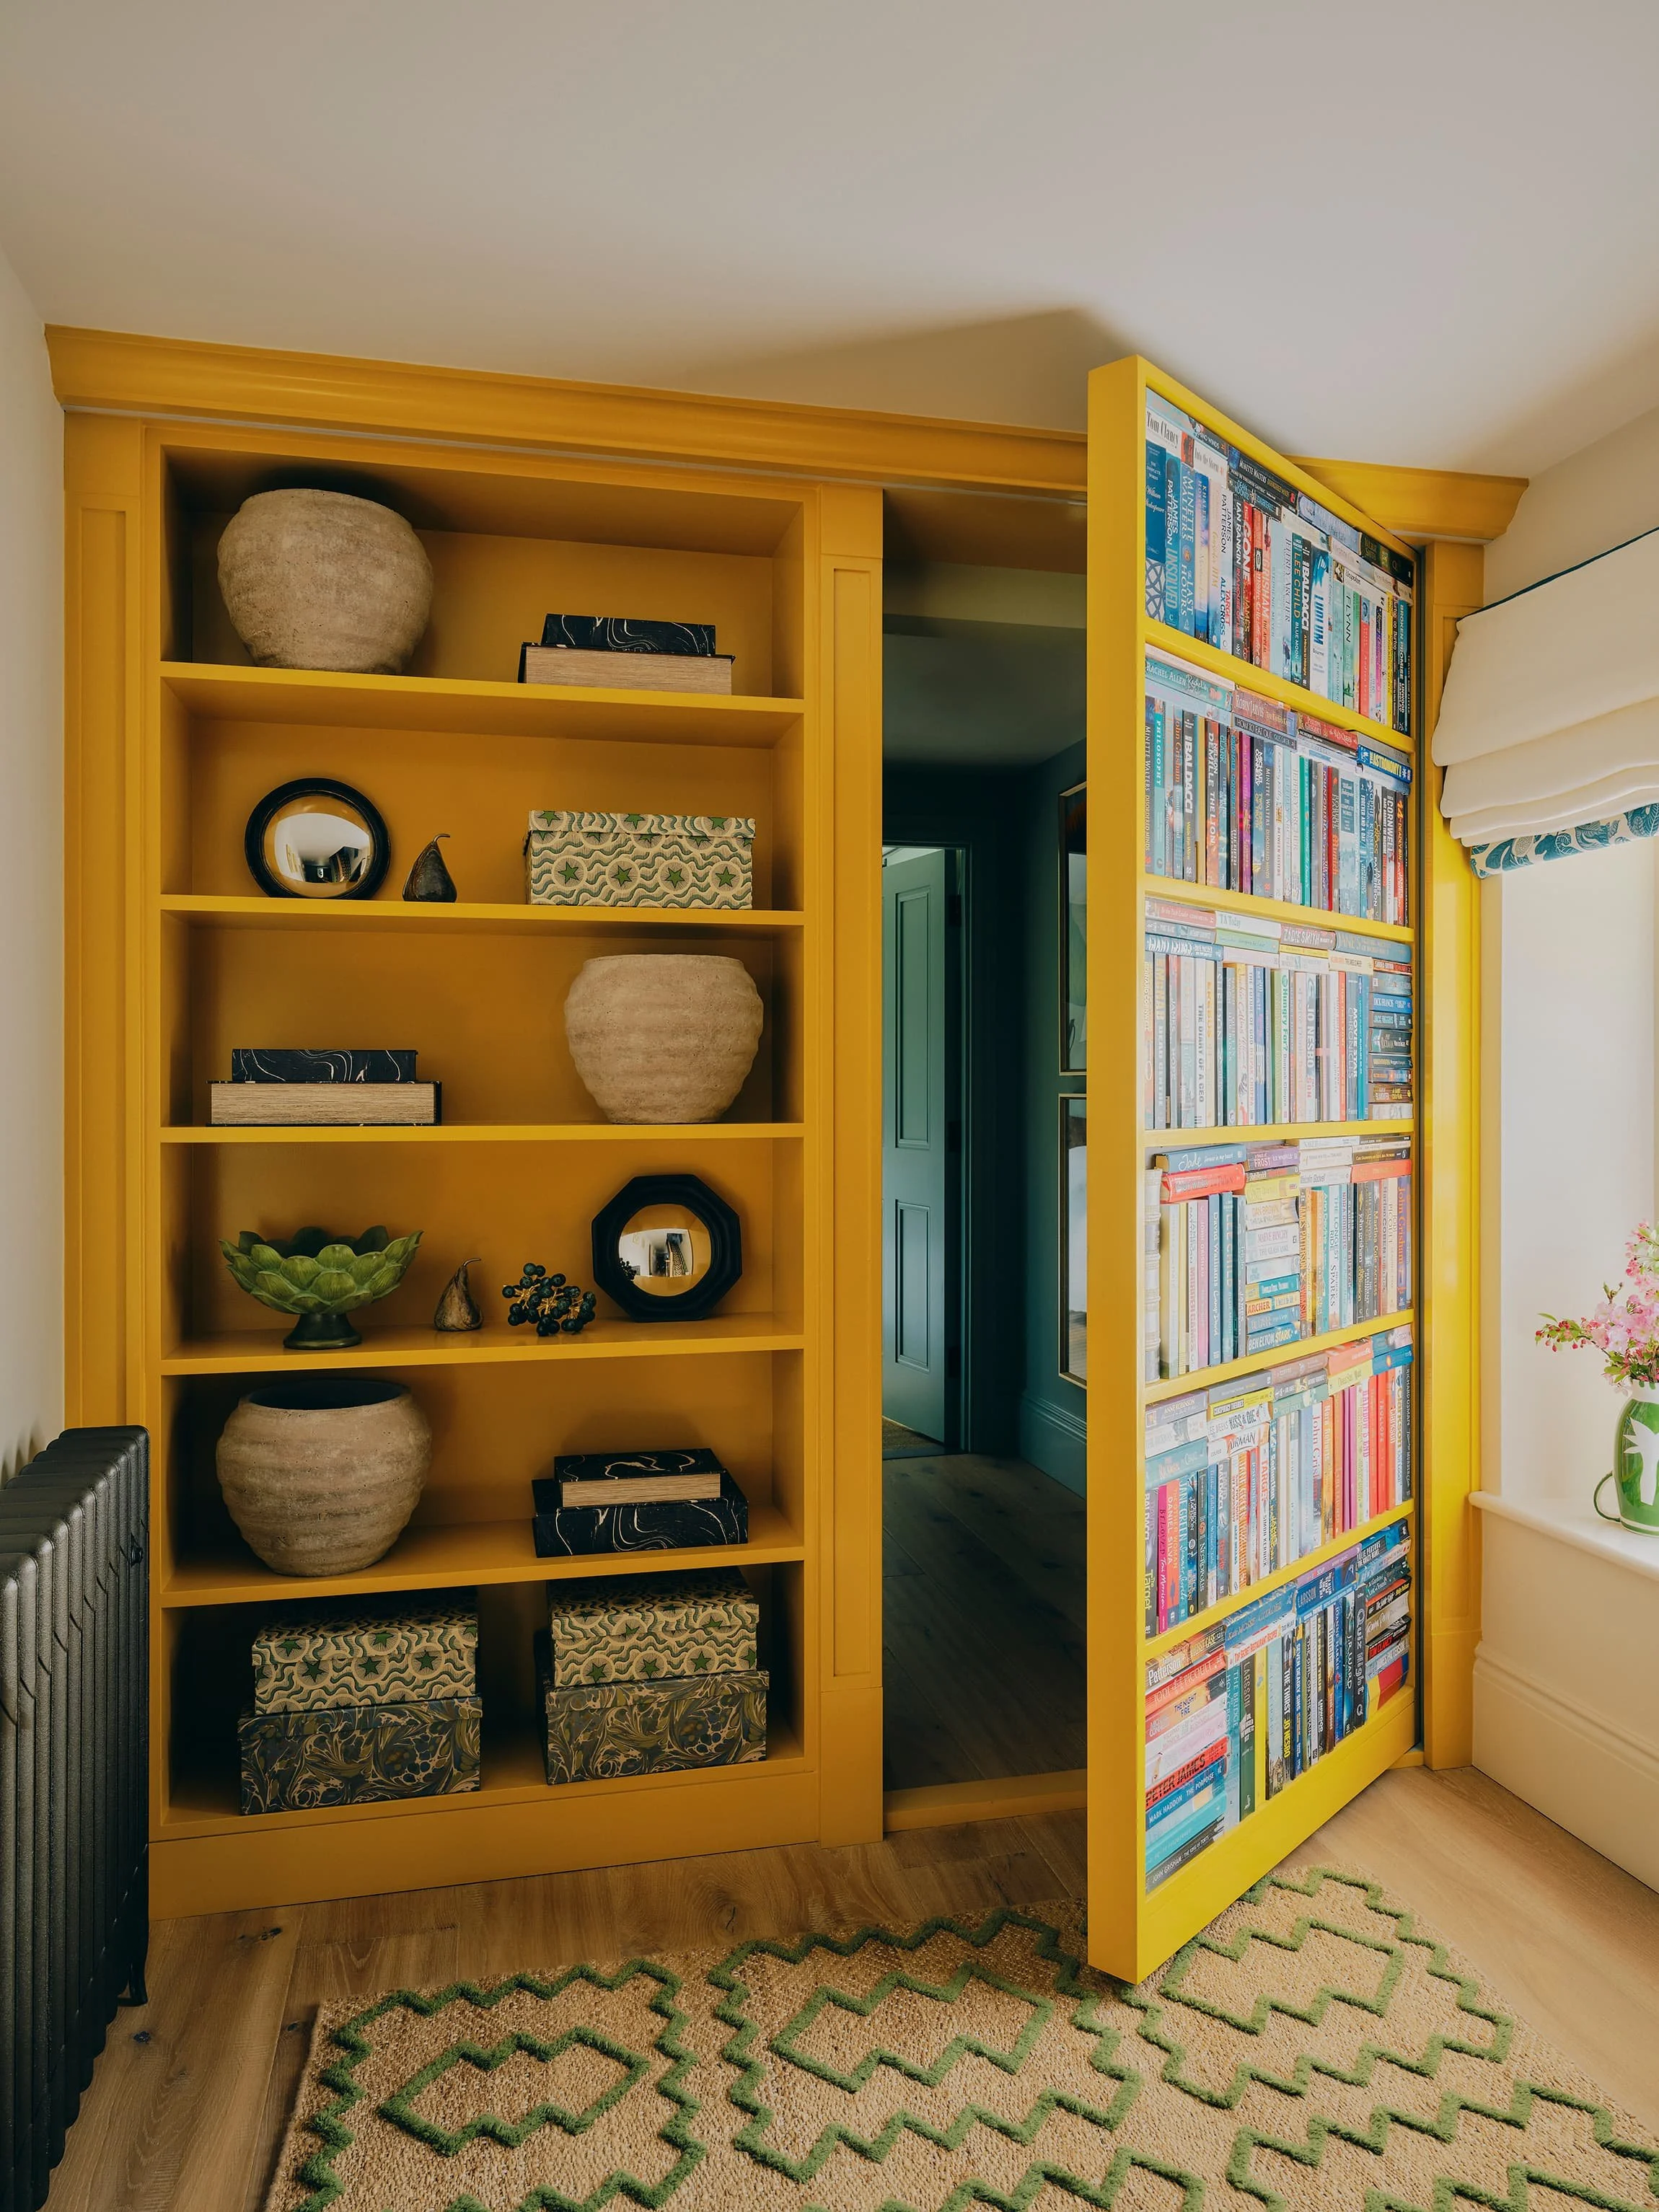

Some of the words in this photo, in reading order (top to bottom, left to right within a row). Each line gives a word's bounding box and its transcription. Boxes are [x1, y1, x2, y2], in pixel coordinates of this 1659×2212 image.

[1147, 411, 1159, 433] Tom
[1161, 420, 1179, 449] Clancy
[1166, 548, 1178, 609] UNSOLVED
[1238, 720, 1248, 732] HOW
[1263, 729, 1272, 741] OUT
[1284, 929, 1301, 945] ZADIE
[1301, 932, 1320, 946] SMITH
[1306, 1004, 1314, 1021] JO
[1198, 1058, 1204, 1072] OF
[1254, 1158, 1271, 1168] FROST
[1247, 1300, 1271, 1314] ARCHER
[1229, 1414, 1242, 1430] KISS
[1247, 1409, 1257, 1424] DIE
[1312, 1416, 1321, 1445] John
[1179, 1482, 1188, 1506] JANE
[1179, 1507, 1188, 1542] GREEN
[1298, 1585, 1317, 1609] LARSSON
[1356, 1608, 1365, 1650] Quiz
[1148, 1660, 1182, 1687] Patterson
[1356, 1652, 1365, 1696] Night
[1284, 1719, 1291, 1730] JO
[1145, 1775, 1176, 1807] PETER
[1176, 1753, 1205, 1786] JAMES
[1148, 1807, 1163, 1824] MARK
[1162, 1794, 1184, 1815] HADDON
